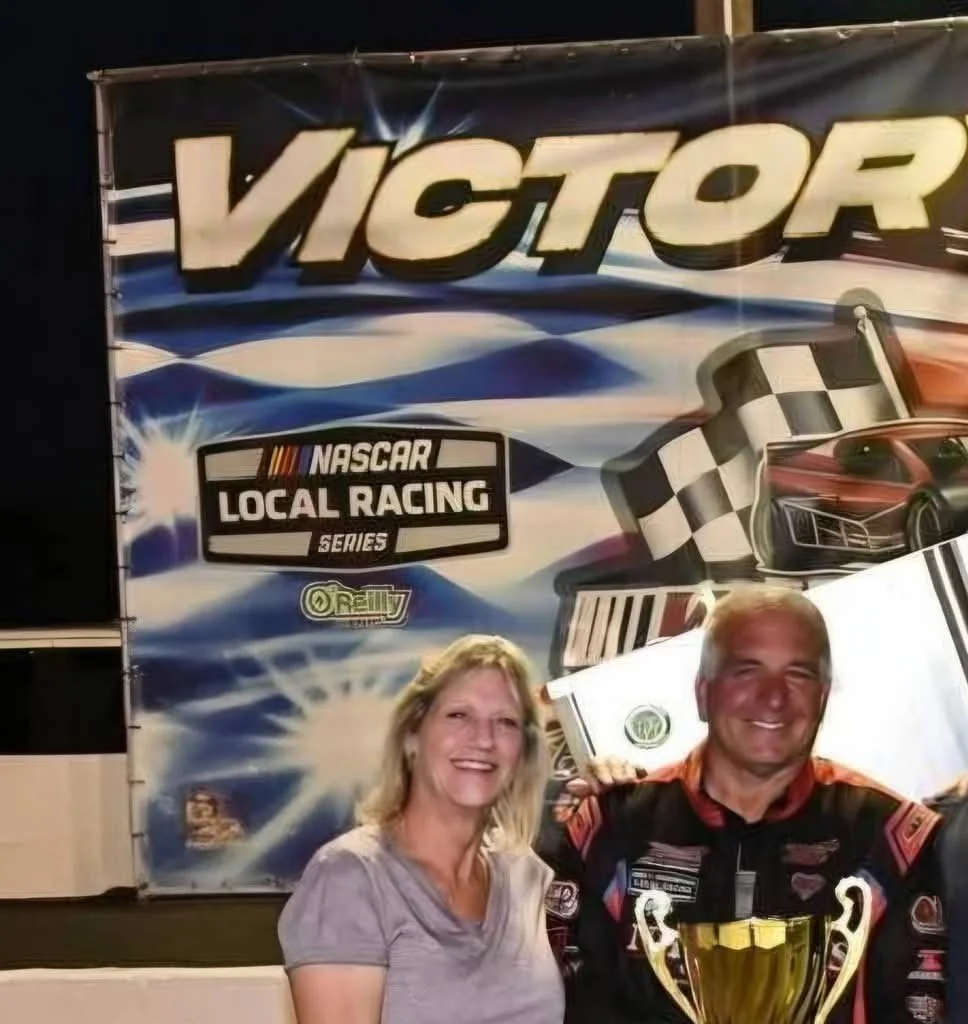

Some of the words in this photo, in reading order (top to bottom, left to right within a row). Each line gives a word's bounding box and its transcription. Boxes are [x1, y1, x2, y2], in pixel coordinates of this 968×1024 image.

[309, 438, 432, 475] NASCAR
[218, 486, 340, 523] LOCAL
[349, 479, 489, 518] RACING
[317, 531, 389, 554] SERIES
